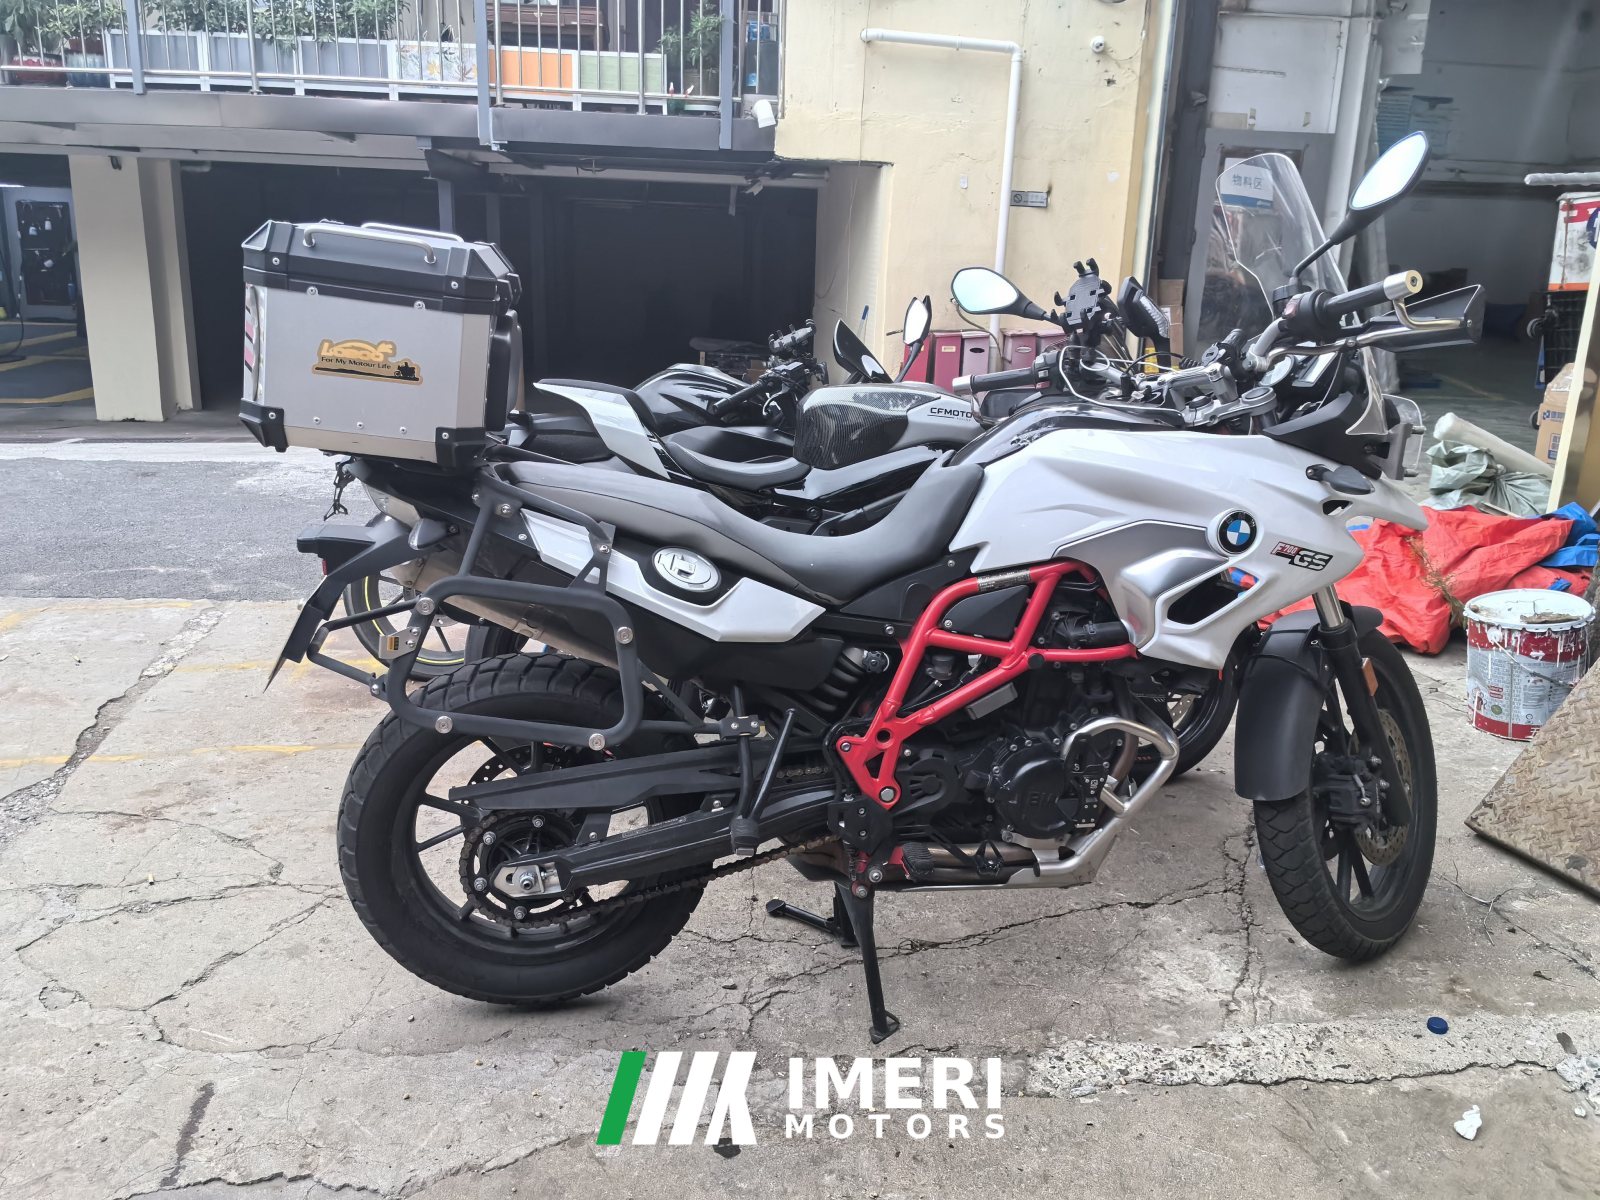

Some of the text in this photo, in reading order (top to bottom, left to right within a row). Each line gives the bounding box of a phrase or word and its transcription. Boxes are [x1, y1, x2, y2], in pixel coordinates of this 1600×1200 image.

[335, 358, 347, 366] My
[348, 359, 376, 369] Motour
[377, 362, 392, 370] Life
[930, 407, 973, 419] CFMOTO
[1293, 550, 1331, 571] GS
